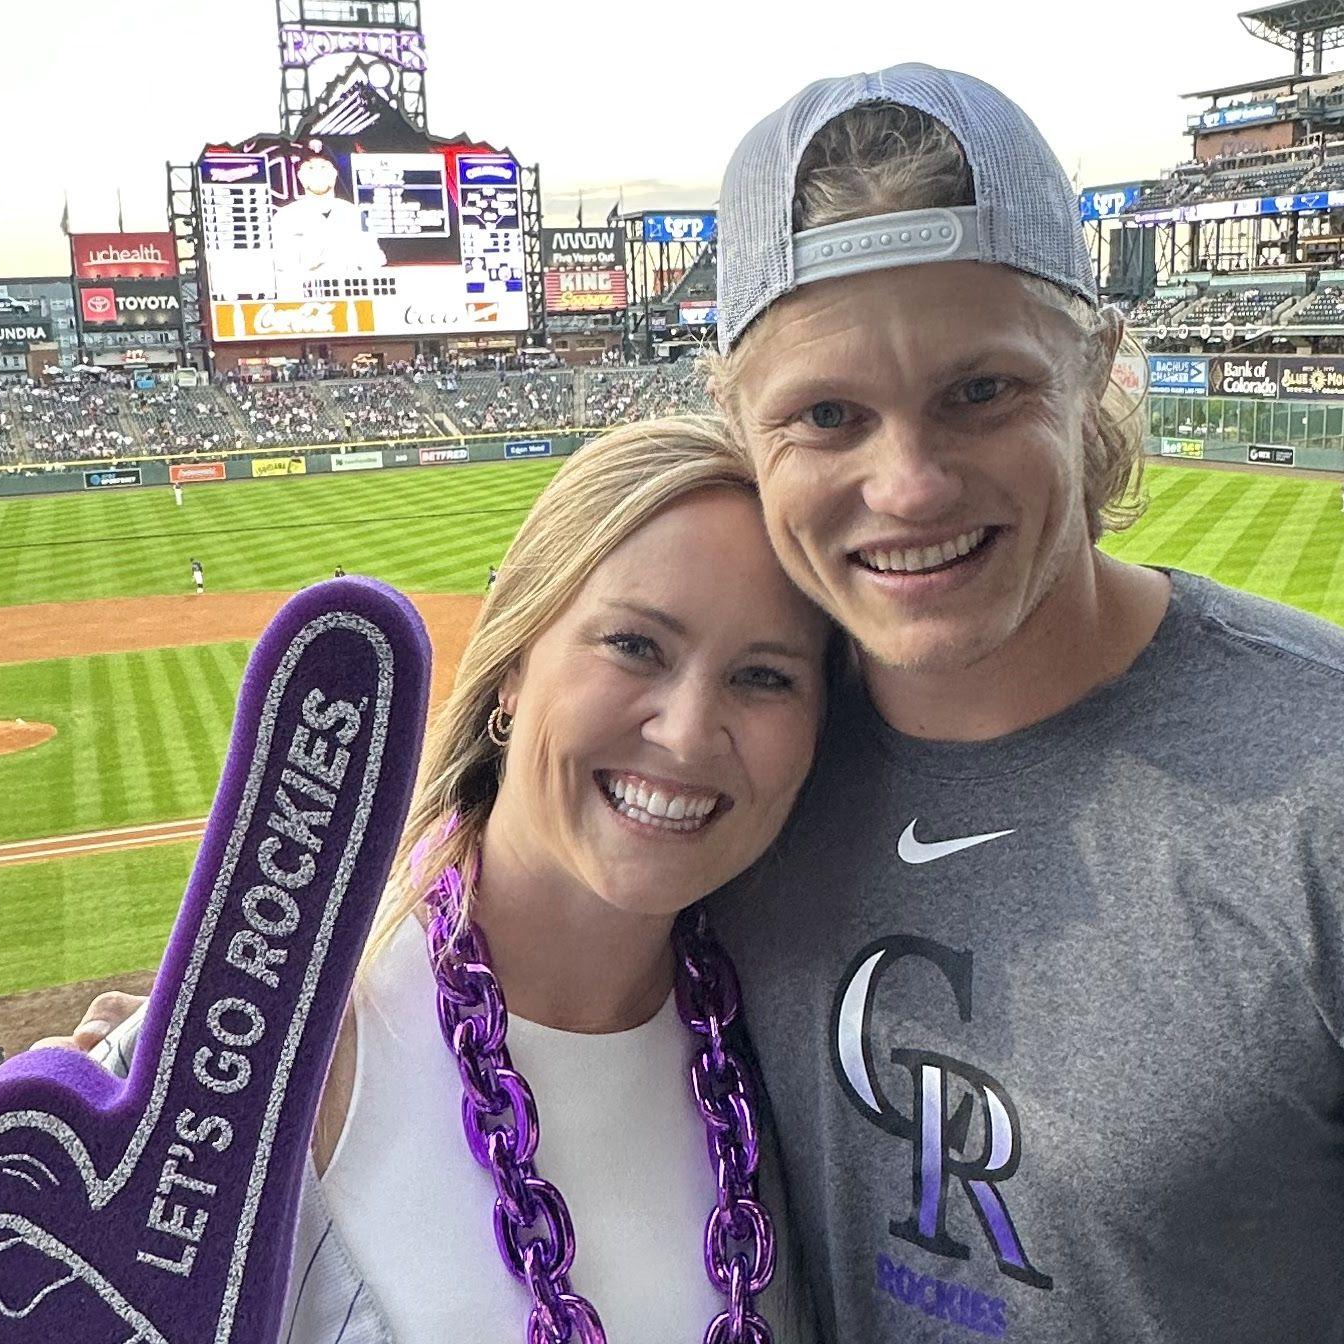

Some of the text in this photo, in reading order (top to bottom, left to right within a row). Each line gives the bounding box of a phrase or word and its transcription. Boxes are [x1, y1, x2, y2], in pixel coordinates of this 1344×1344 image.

[552, 232, 615, 250] ARROW
[89, 243, 162, 263] uchealth
[552, 252, 616, 263] Five Years Out
[559, 272, 613, 292] KING
[116, 295, 180, 312] TOYOTA
[1223, 360, 1269, 378] Bank of
[1223, 377, 1278, 395] Colorado
[1281, 370, 1309, 387] BLUE
[422, 449, 468, 463] BETFRED
[137, 687, 361, 1278] LET'S GO ROCKIES
[875, 1250, 1008, 1341] ROCKIES
